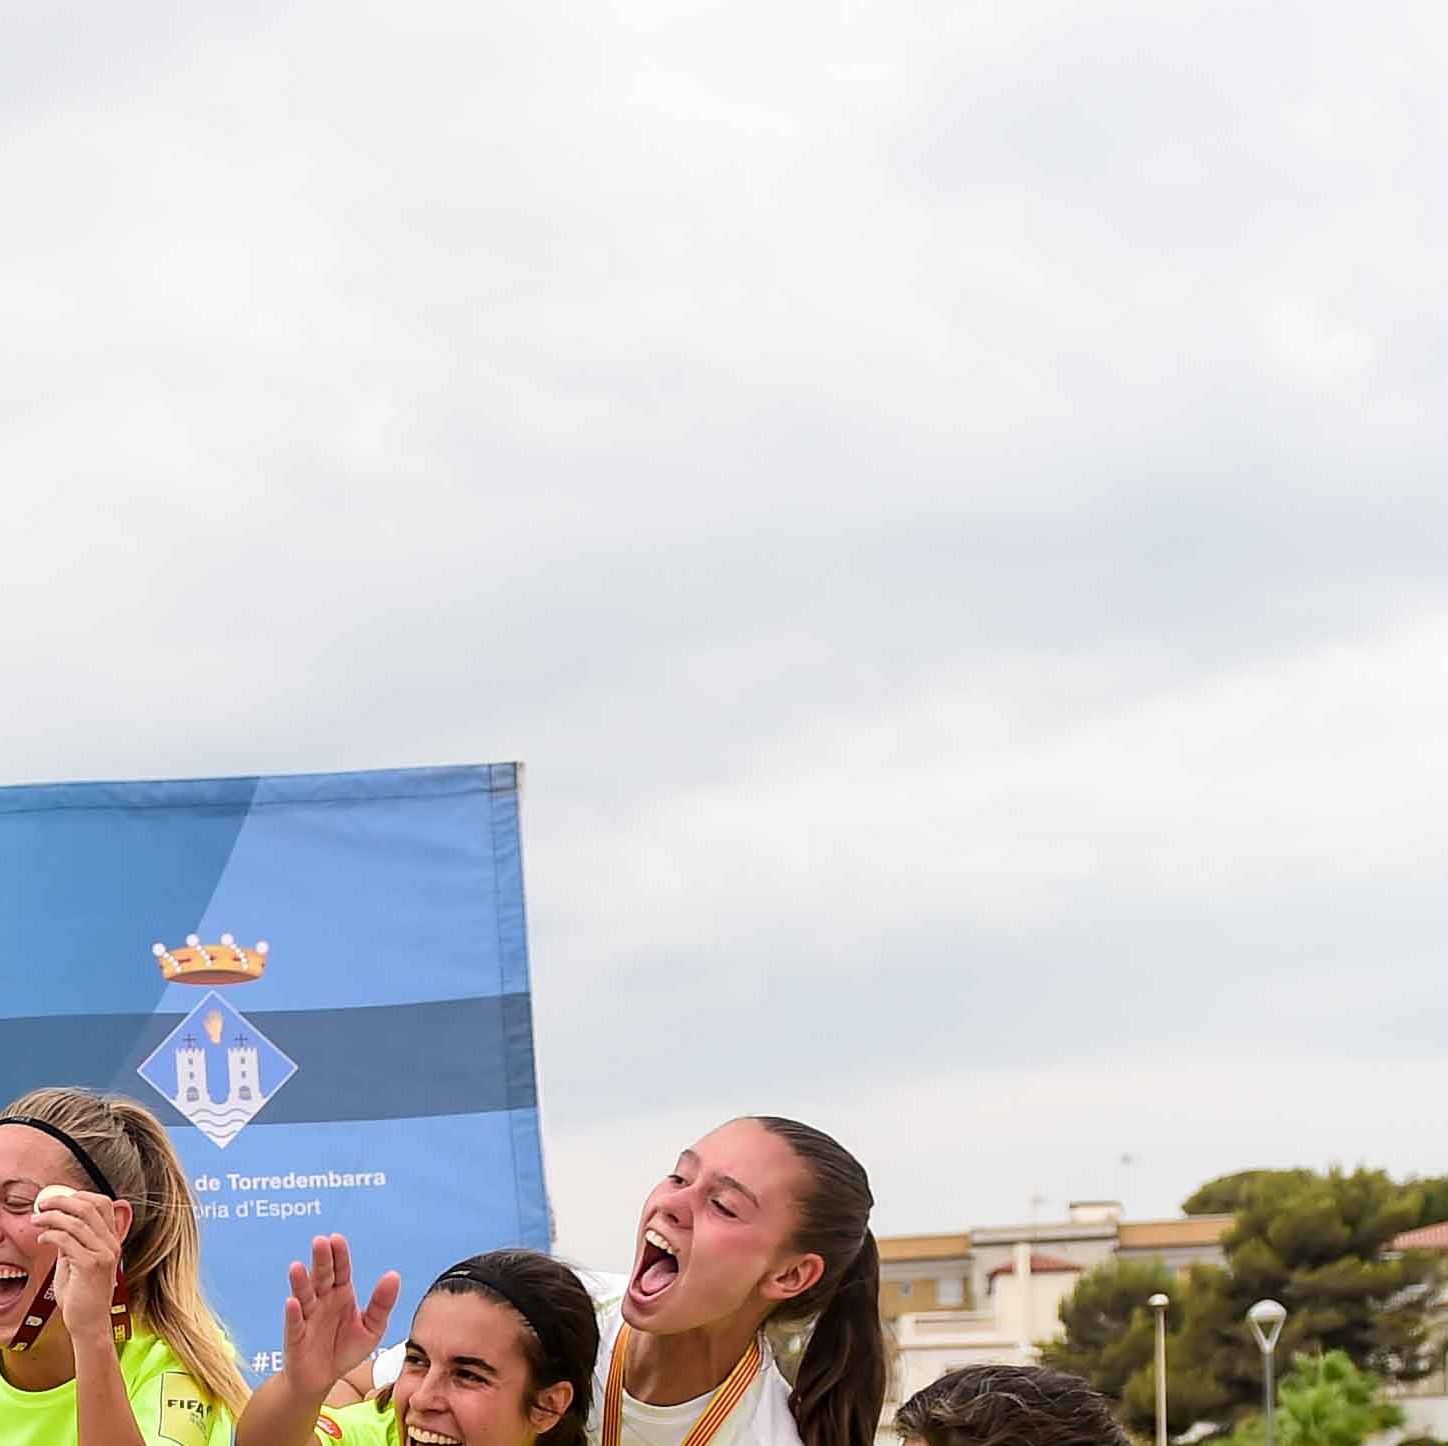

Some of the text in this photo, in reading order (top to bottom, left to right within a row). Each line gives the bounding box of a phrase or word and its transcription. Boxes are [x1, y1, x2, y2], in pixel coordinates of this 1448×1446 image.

[194, 1171, 386, 1191] de Torredembarra
[236, 1199, 322, 1220] d'Esport
[167, 1399, 205, 1419] FIFA
